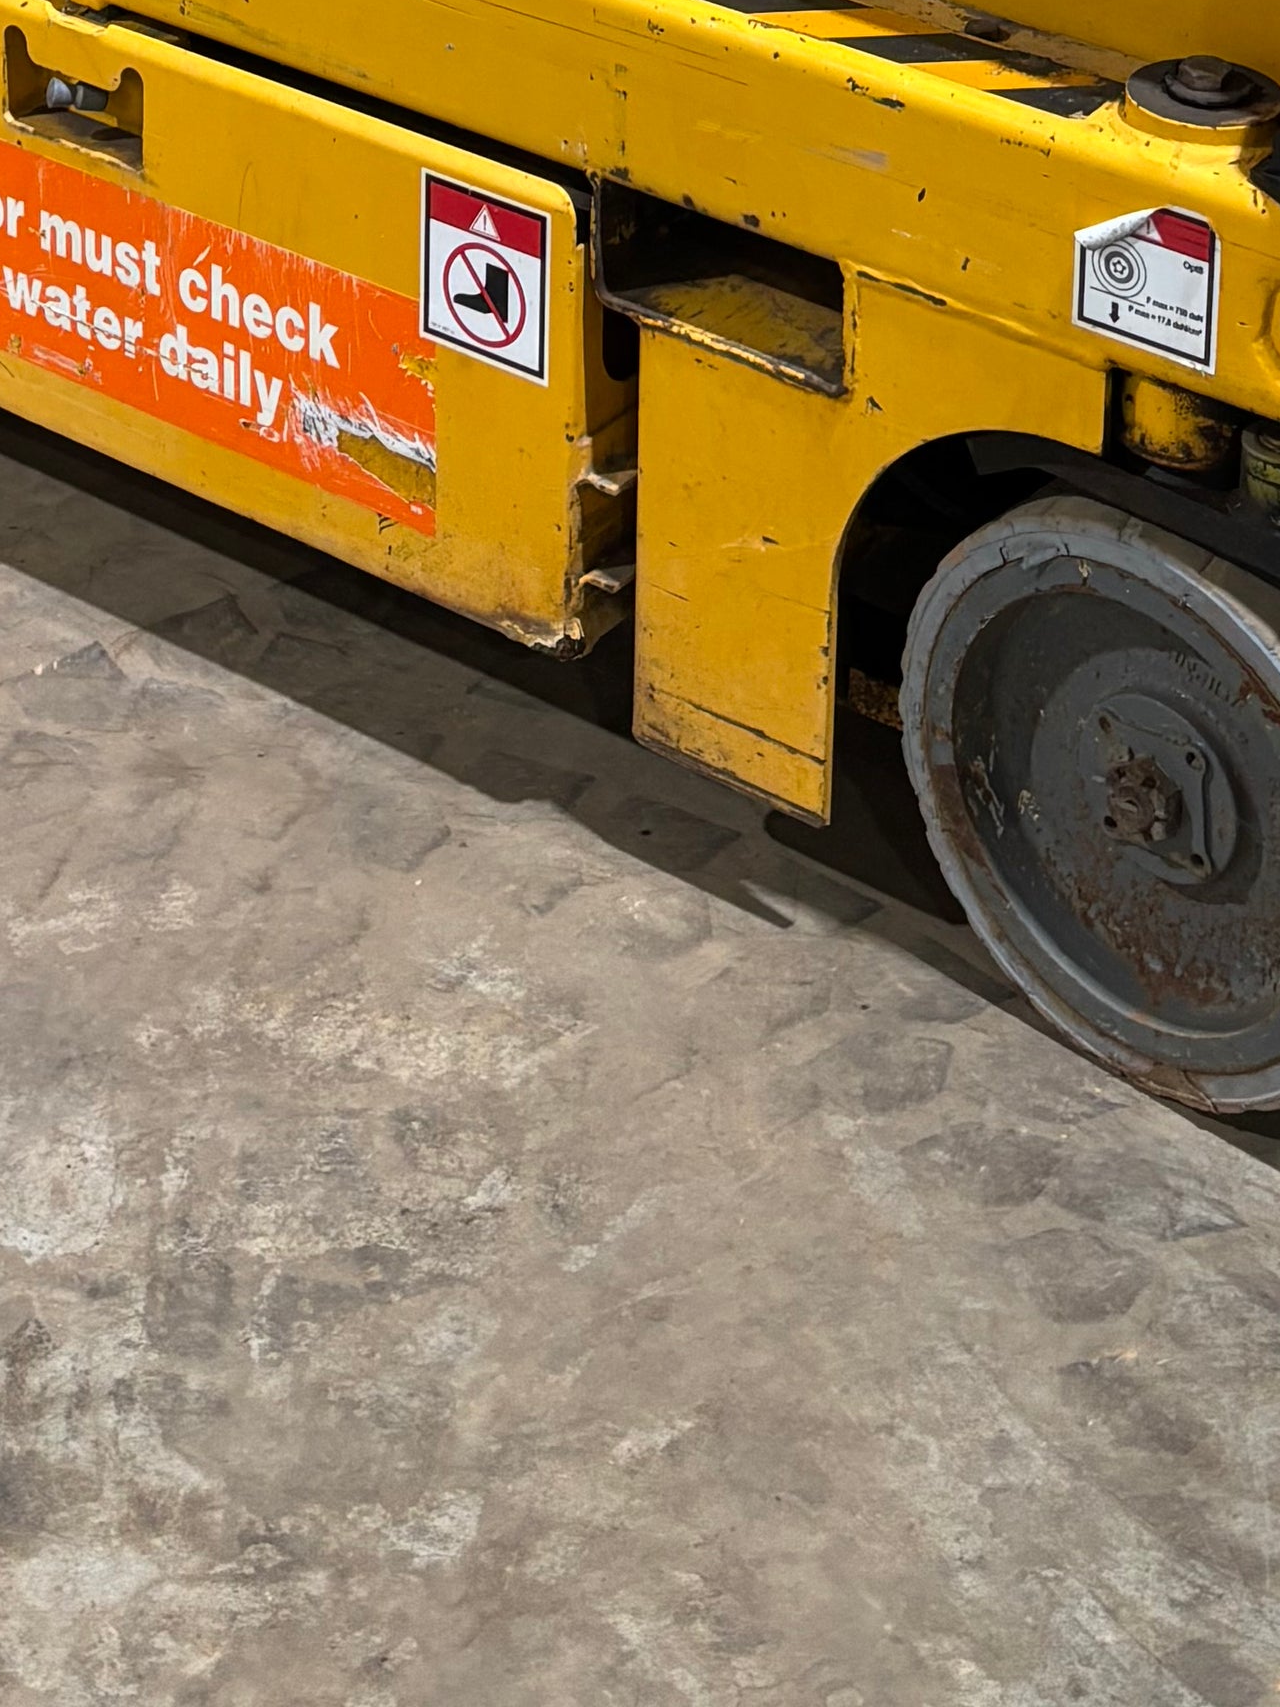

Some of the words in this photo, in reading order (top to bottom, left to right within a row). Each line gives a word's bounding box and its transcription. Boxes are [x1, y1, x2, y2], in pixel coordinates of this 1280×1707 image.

[3, 265, 144, 359] water
[160, 324, 283, 426] daily
[40, 209, 161, 297] must
[178, 263, 341, 369] check
